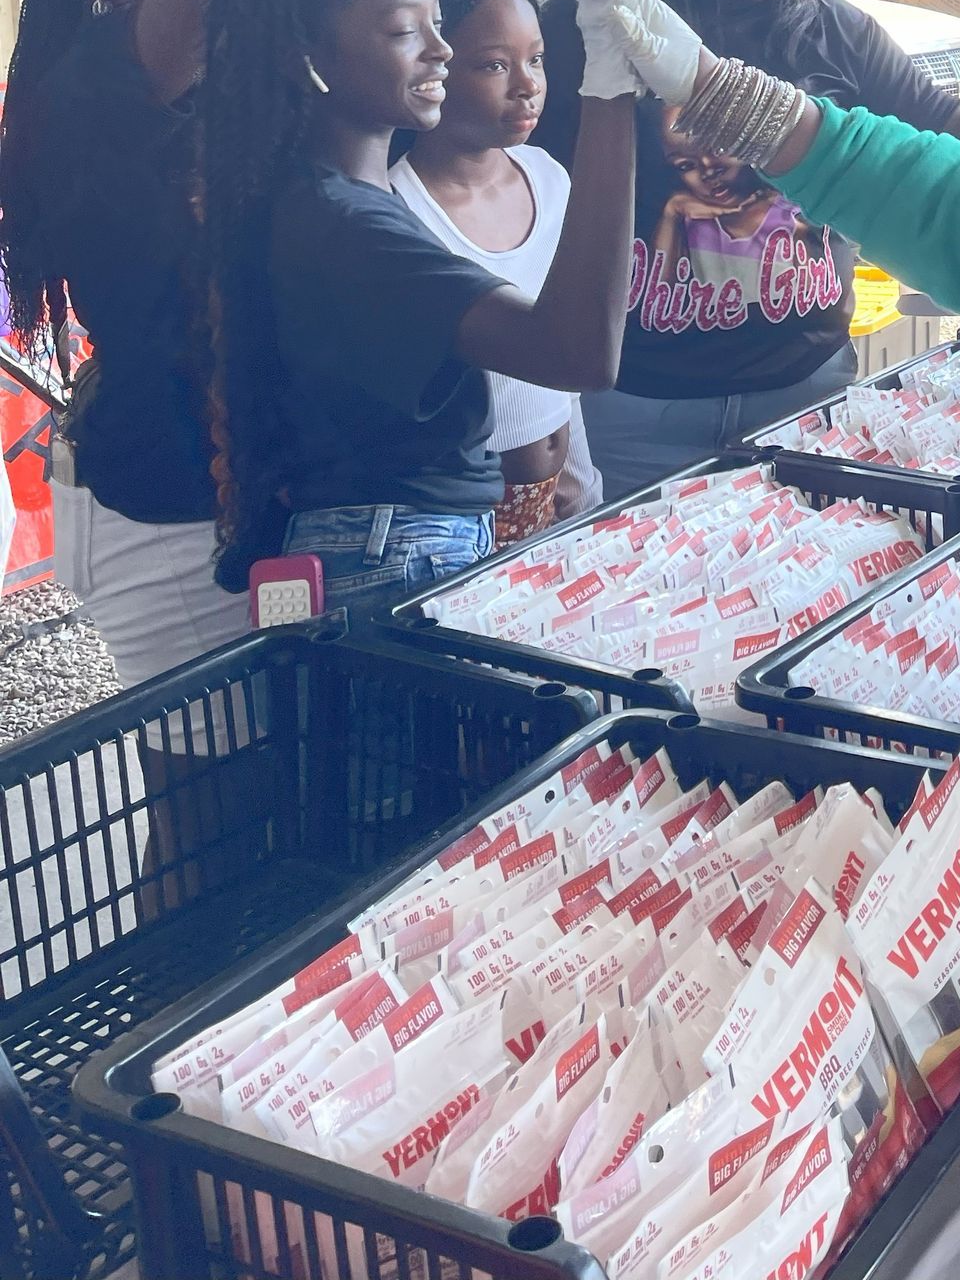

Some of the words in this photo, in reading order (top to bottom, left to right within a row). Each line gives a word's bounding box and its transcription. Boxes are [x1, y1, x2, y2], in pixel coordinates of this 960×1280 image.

[760, 226, 842, 323] Girl
[701, 685, 713, 696] 100
[694, 866, 708, 882] 100
[855, 902, 869, 923] 100
[868, 888, 879, 902] 6g
[877, 874, 888, 888] 2g
[404, 911, 419, 927] 100
[782, 938, 799, 961] BIG
[797, 905, 821, 941] FLAVOR
[467, 972, 486, 990] 100
[489, 962, 500, 975] 6g
[503, 954, 514, 966] 2g
[472, 947, 487, 962] 100
[546, 968, 562, 986] 100
[564, 962, 575, 973] 6g
[576, 954, 587, 965] 2g
[585, 972, 596, 988] 100
[672, 999, 686, 1016] 100
[685, 989, 695, 1002] 6g
[394, 1030, 409, 1047] BIG
[408, 1001, 439, 1034] FLAVOR
[715, 1034, 730, 1056] 100
[730, 1020, 741, 1034] 6g
[738, 1007, 749, 1020] 2g
[750, 955, 863, 1120] VERMONT
[827, 1009, 846, 1034] SMOKE
[173, 1063, 191, 1083] 100
[196, 1056, 208, 1068] 6g
[211, 1047, 224, 1059] 2g
[238, 1082, 255, 1102] 100
[259, 1073, 270, 1086] 6g
[274, 1062, 286, 1075] 2g
[558, 1071, 570, 1094] BIG
[570, 1044, 598, 1080] FLAVOR
[818, 1054, 842, 1092] BBQ
[826, 1081, 840, 1106] MINI
[854, 1030, 871, 1060] STICKS
[287, 1100, 305, 1121] 100
[322, 1079, 334, 1092] 2g
[713, 1165, 732, 1187] BIG
[733, 1135, 767, 1170] FLAVOR
[617, 1248, 631, 1270] 100
[635, 1236, 643, 1249] 6g
[670, 1246, 685, 1268] 100
